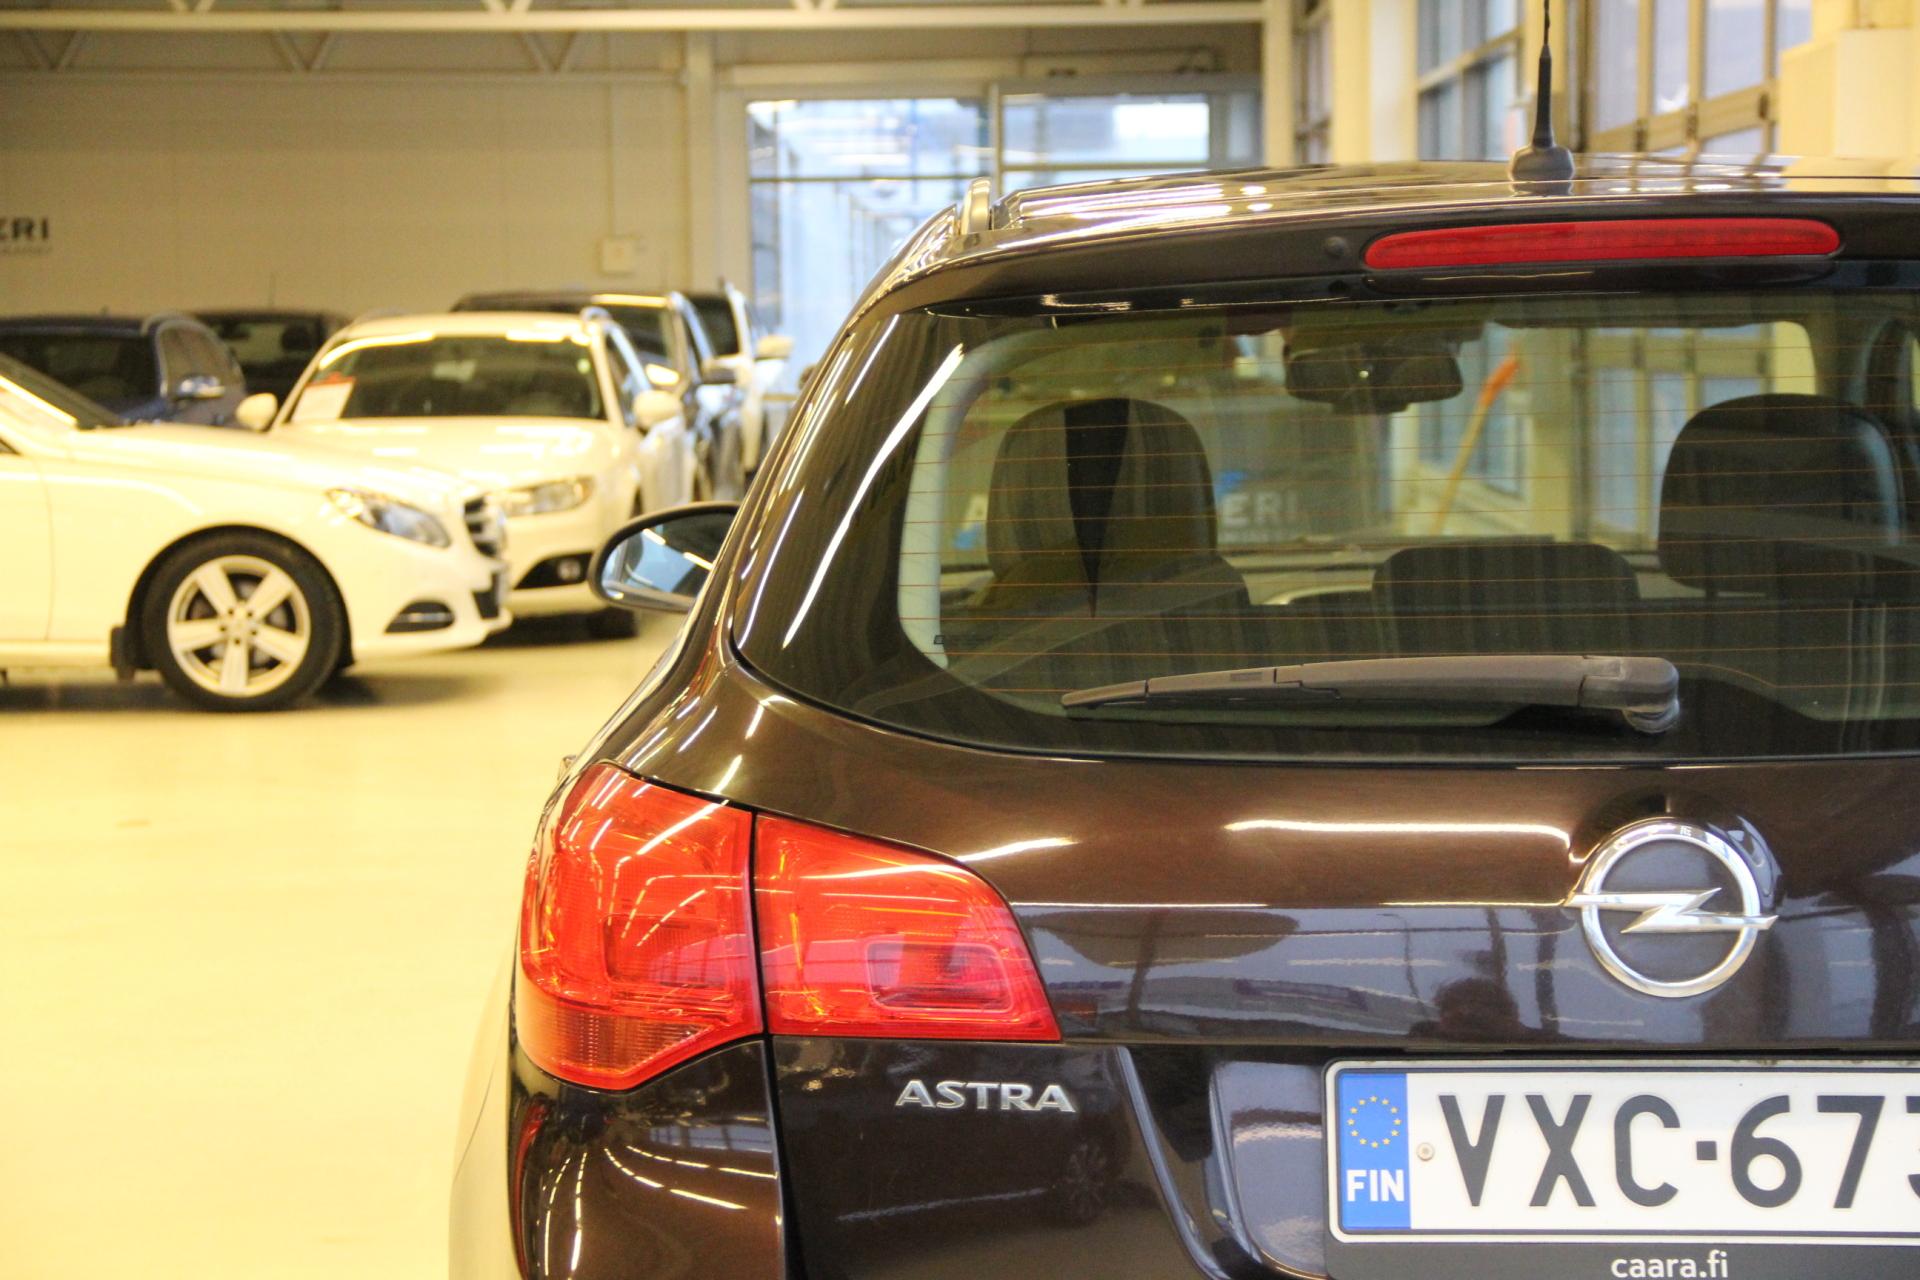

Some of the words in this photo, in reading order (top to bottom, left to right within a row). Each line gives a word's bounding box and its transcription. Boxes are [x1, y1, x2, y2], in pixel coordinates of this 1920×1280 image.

[895, 1079, 1076, 1113] ASTRA
[1438, 1093, 1920, 1208] VXC-67
[1346, 1170, 1405, 1202] FIN
[1610, 1249, 1729, 1279] caara.fi
